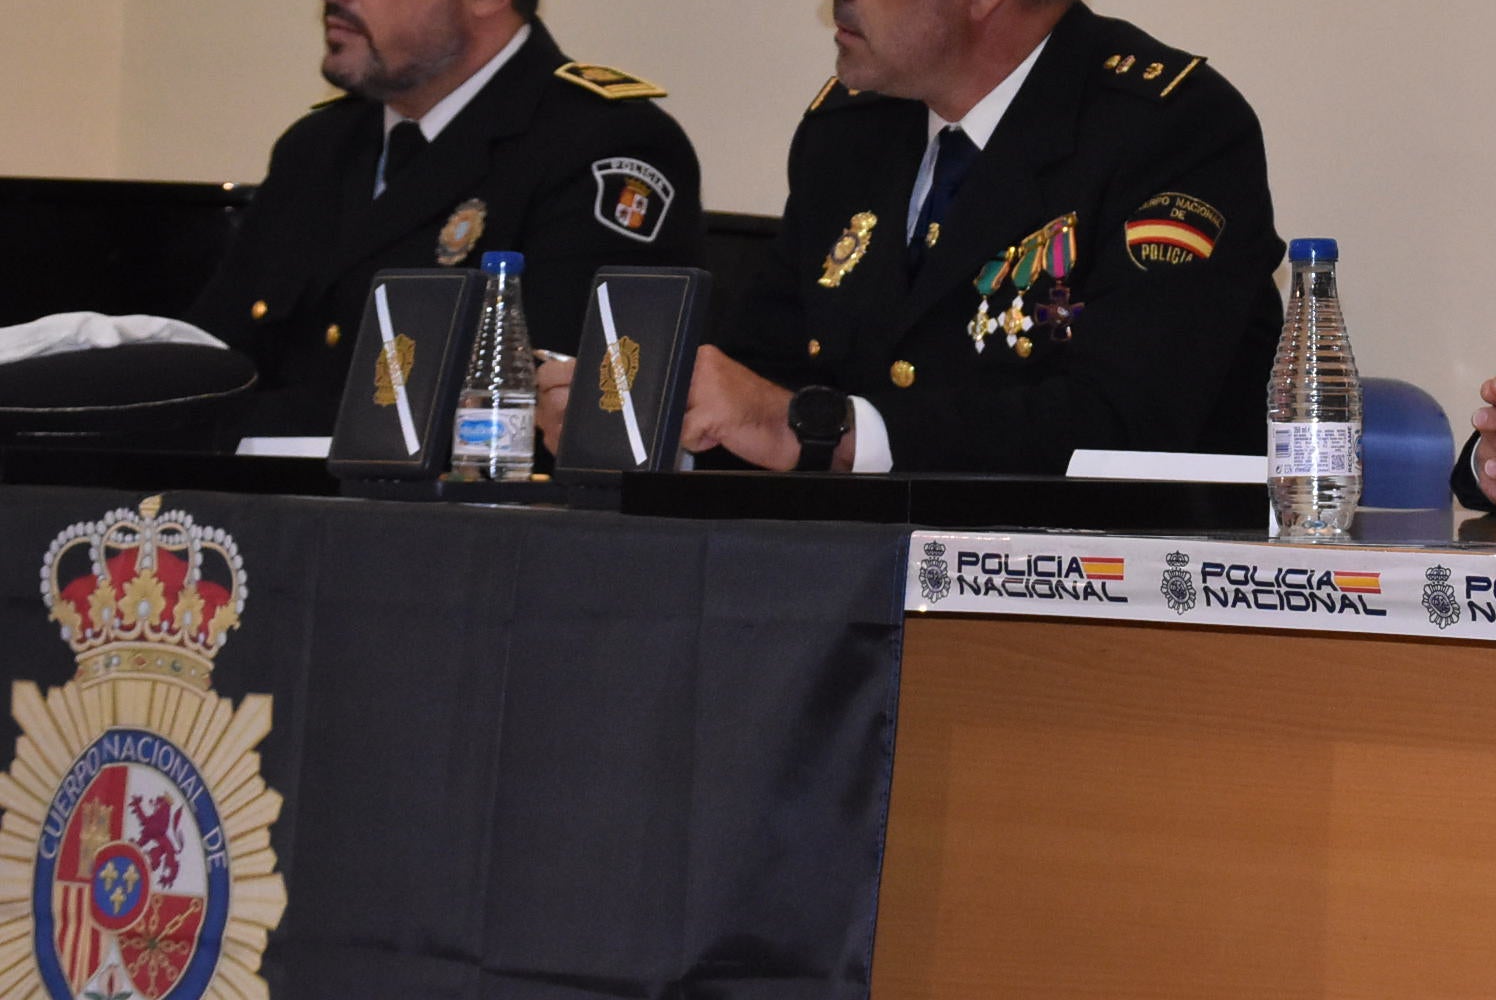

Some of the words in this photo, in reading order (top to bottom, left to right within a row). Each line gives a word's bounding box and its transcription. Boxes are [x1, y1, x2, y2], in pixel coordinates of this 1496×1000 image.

[1170, 207, 1187, 220] DE
[956, 575, 1129, 603] NACIONAL
[1203, 586, 1387, 616] NACIONAL
[39, 747, 101, 860] CUERPO
[102, 734, 204, 813] NACIONAL
[203, 826, 227, 873] DE
